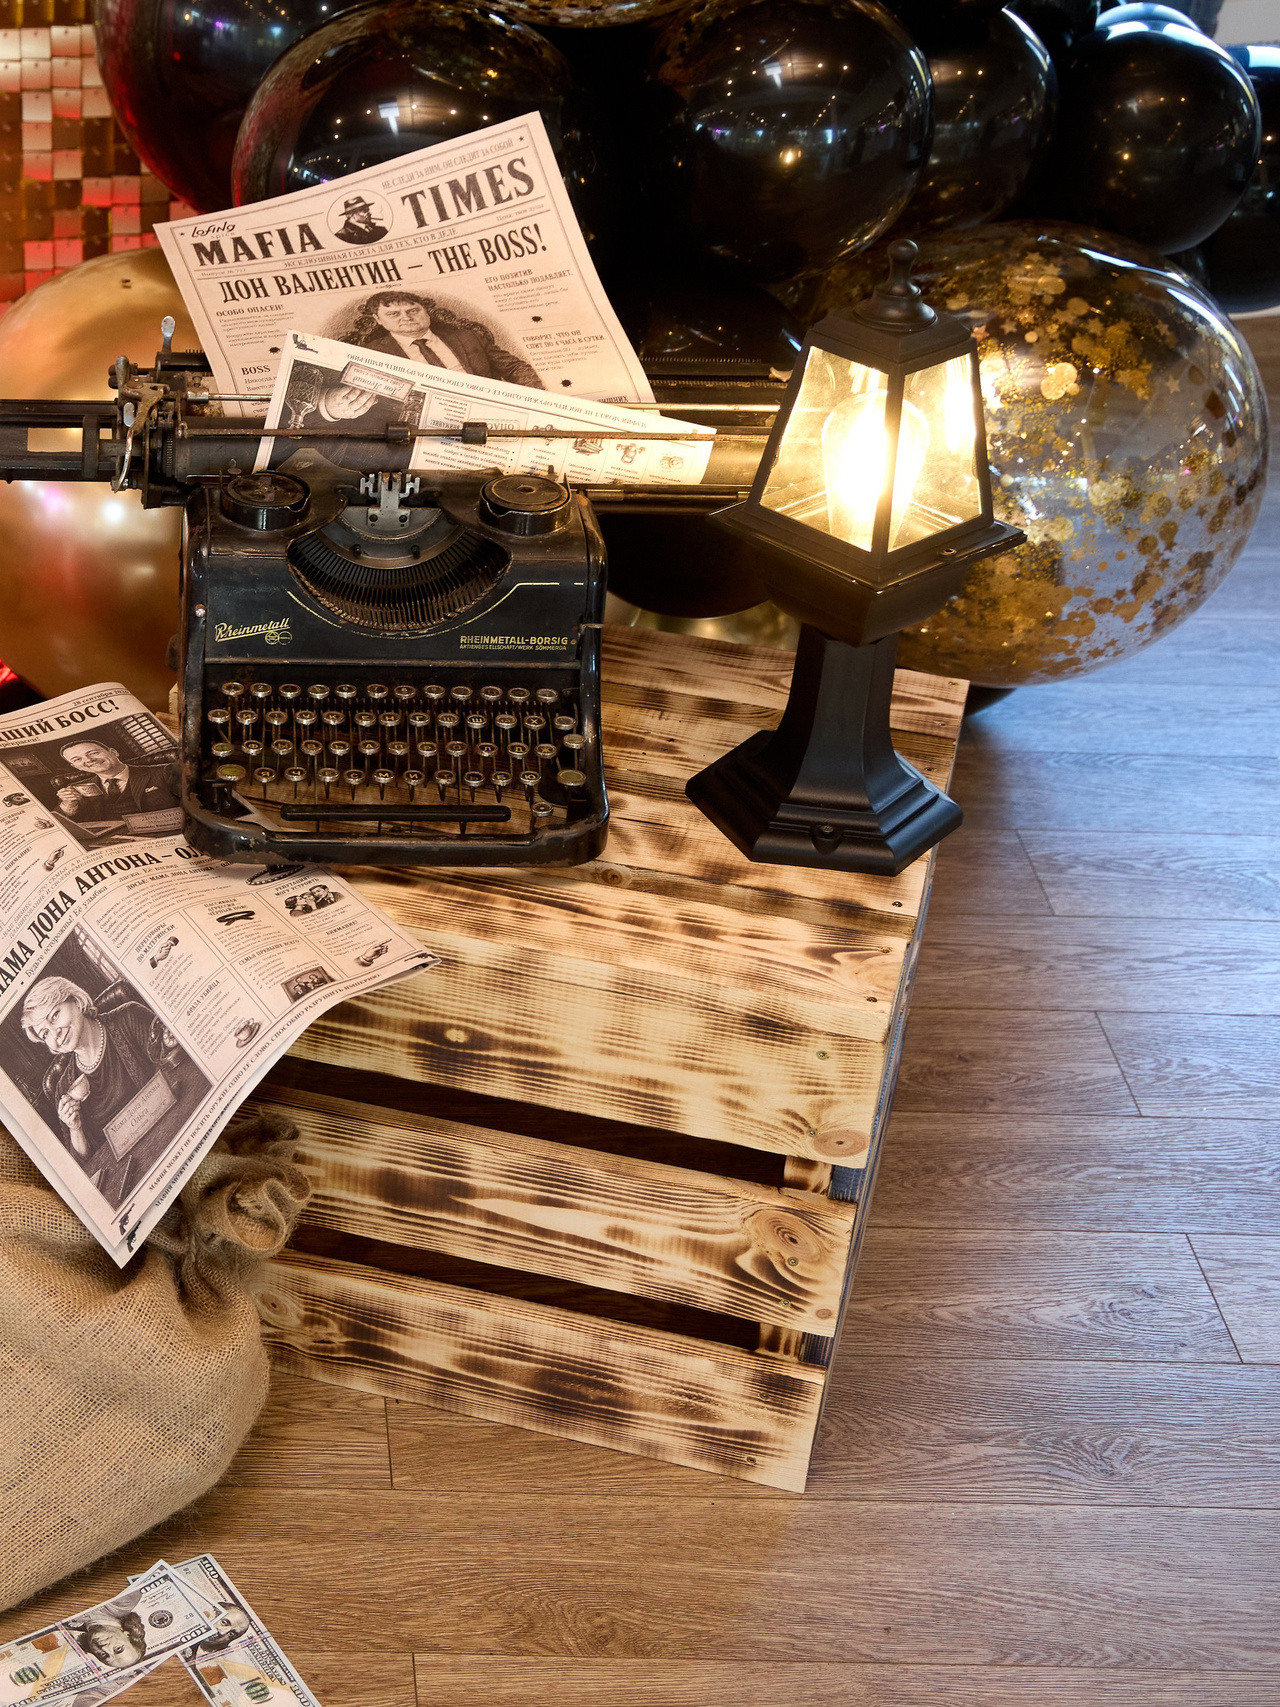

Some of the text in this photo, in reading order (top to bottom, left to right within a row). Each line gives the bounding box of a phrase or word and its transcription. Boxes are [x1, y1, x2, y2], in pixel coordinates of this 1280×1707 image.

[391, 172, 416, 187] СЛЕДИ
[453, 150, 480, 166] СЛЕДИТ
[489, 138, 514, 154] СОБОЙ
[191, 157, 536, 267] MAFIA TIMES
[218, 223, 548, 303] ДОН ВАЛЕНТИН THE BOSS!
[484, 269, 533, 284] ЕГО ПОЗИТИВ
[487, 279, 529, 292] НАСТОЛЬКО
[216, 304, 284, 317] ОСОБО ОПАСЕН!
[525, 342, 543, 350] СПИТ
[559, 338, 578, 346] ЧАСА
[555, 331, 571, 339] ЧТО
[241, 365, 271, 376] BOSS
[214, 617, 290, 642] Rheinmetall
[460, 635, 568, 645] RHEINMETALL-BORSIG
[54, 700, 120, 730] БОСС!
[149, 873, 170, 882] МАМА
[170, 870, 188, 878] ДОНА
[189, 863, 215, 874] АНТОНА
[290, 876, 320, 891] УСТРОИТЬ
[27, 890, 77, 948] ДОНА
[75, 851, 162, 894] АНТОНА
[24, 954, 44, 978] Будьте
[43, 914, 75, 955] осторожны!
[82, 886, 108, 910] улыбка
[118, 871, 143, 883] ласка.
[325, 920, 359, 936] ВНИМАНИЕ!
[135, 922, 167, 953] ПЕРЕГОВОРЫ
[238, 953, 257, 966] СЕМЬЯ
[255, 943, 283, 956] ПРЕВЫШЕ
[186, 979, 221, 1017] ФРАЗА УБИЙЦА
[166, 1147, 185, 1169] МОЖЕТ
[190, 1114, 211, 1139] НОСИТЬ
[270, 1010, 305, 1042] СПОСОБНО
[128, 1105, 150, 1128] Ольга
[201, 1558, 221, 1580] 100
[175, 1624, 214, 1644] 100
